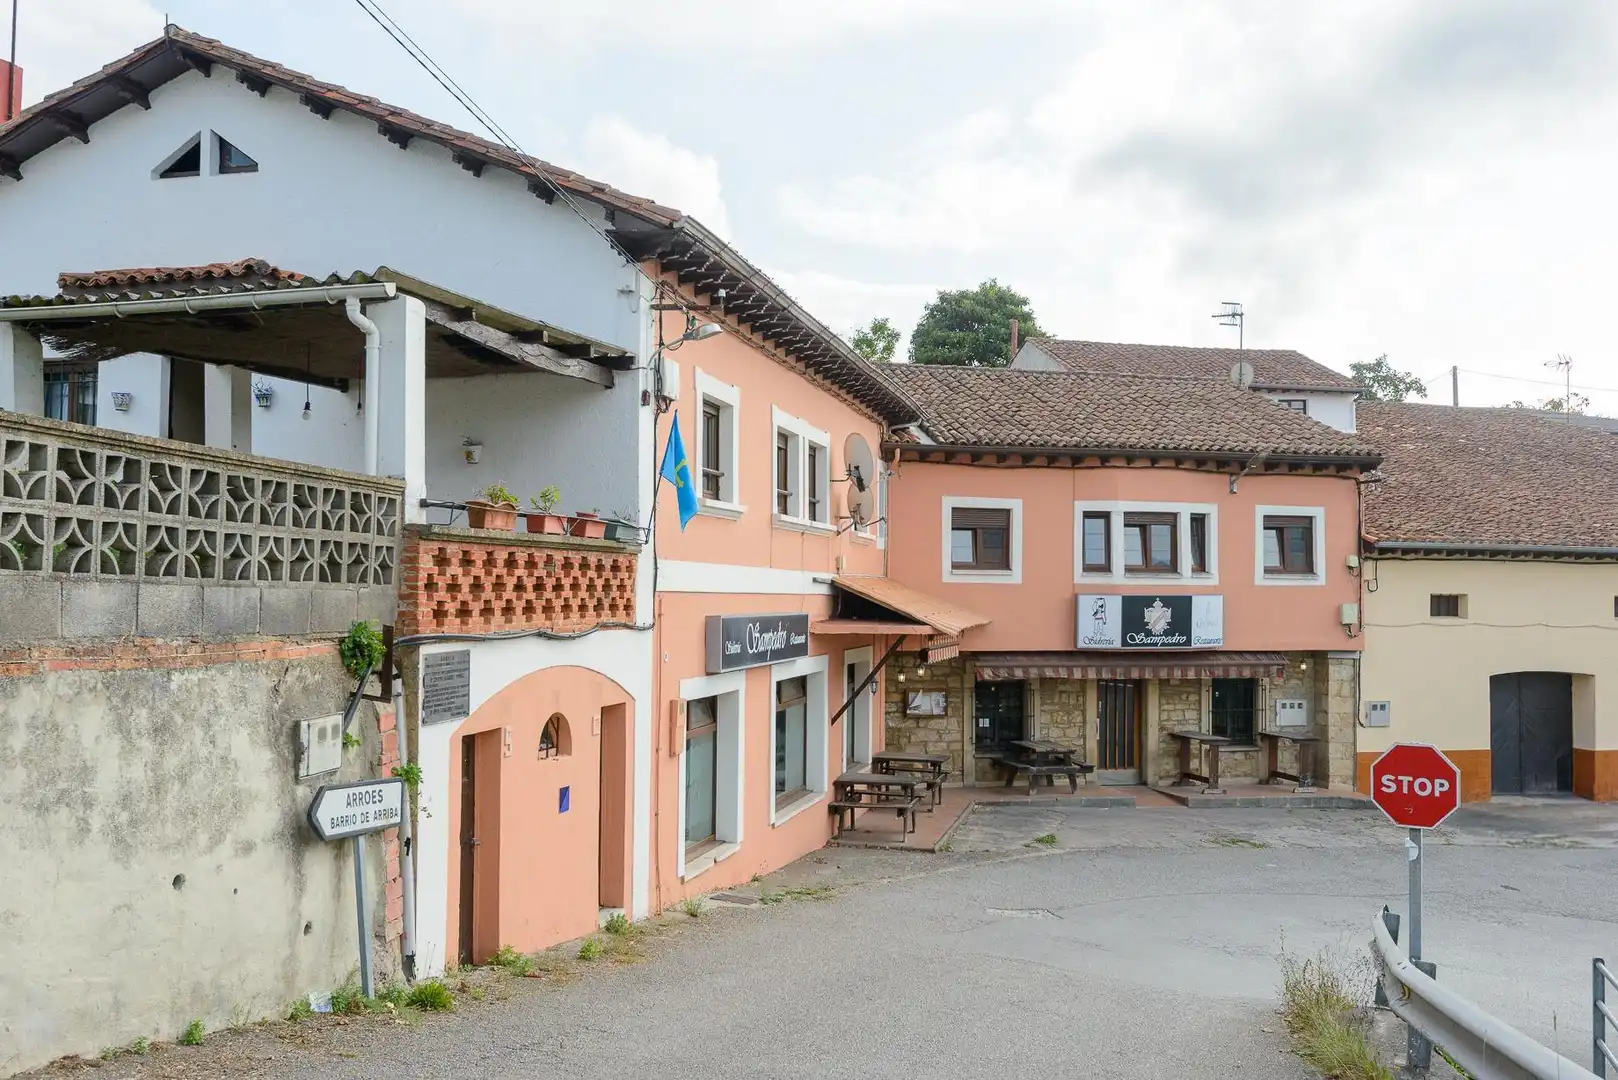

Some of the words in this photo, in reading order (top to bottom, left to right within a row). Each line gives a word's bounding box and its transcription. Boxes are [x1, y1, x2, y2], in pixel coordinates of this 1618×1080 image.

[746, 621, 787, 661] Sampedro
[1127, 632, 1187, 647] Sampedro
[1381, 774, 1449, 797] STOP
[346, 789, 383, 808] ARROES
[330, 813, 357, 829] BARRIO
[360, 811, 370, 824] DE
[373, 807, 399, 822] ARRIBA
